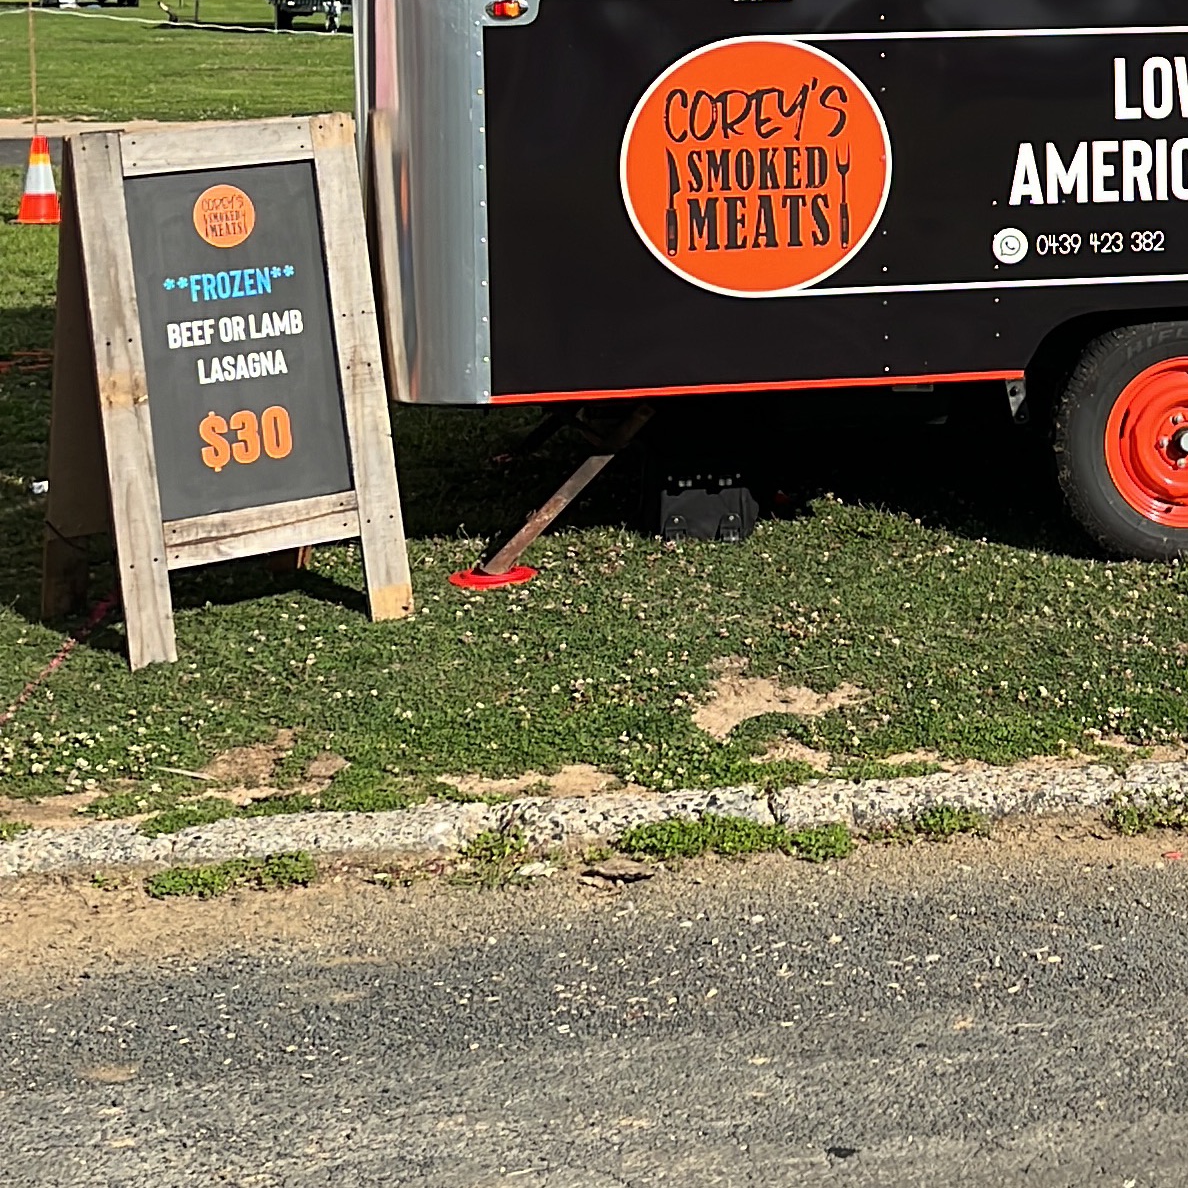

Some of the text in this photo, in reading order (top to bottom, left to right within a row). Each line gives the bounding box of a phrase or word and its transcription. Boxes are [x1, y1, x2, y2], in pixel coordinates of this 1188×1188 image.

[662, 77, 848, 143] COREY'S
[687, 145, 829, 193] SMOKED
[201, 194, 244, 212] COREY'S
[208, 211, 241, 224] SMOKED
[208, 221, 243, 237] MEATS
[686, 193, 831, 252] MEATS
[1036, 230, 1165, 256] 0439 423 382
[167, 309, 304, 349] BEEF OR LAMB
[197, 349, 288, 385] LASAGNA
[199, 405, 293, 472] $30
